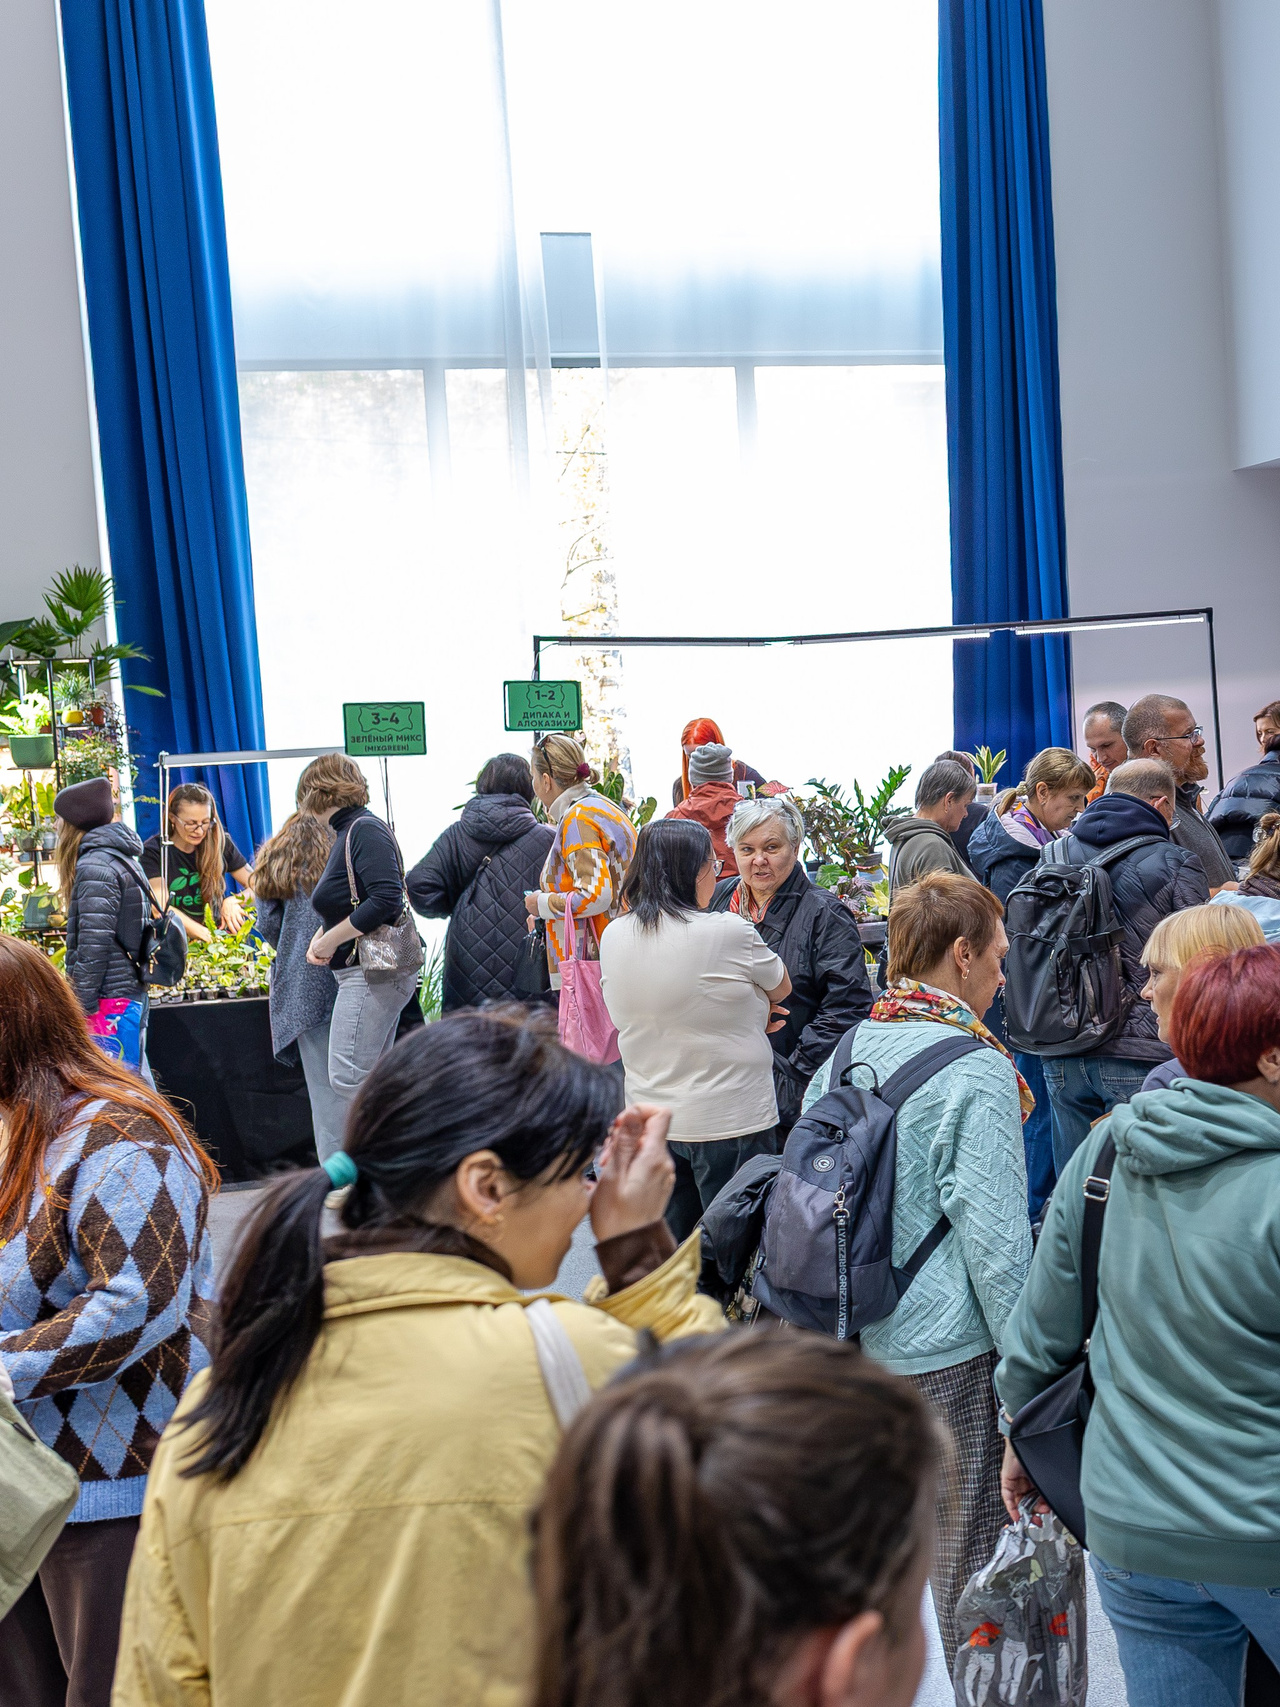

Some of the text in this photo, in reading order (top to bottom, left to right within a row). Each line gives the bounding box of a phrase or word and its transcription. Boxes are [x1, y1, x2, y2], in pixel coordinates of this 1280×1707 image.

[535, 690, 556, 701] 1-2
[371, 712, 400, 725] 3-4
[522, 711, 570, 720] ДИПАКА И
[350, 733, 422, 743] ЗЕЛЁНЫЙ МИКС
[364, 744, 410, 752] (MIXGREEN)
[838, 1237, 847, 1274] GRIZZLY
[837, 1311, 847, 1342] RIZZLY
